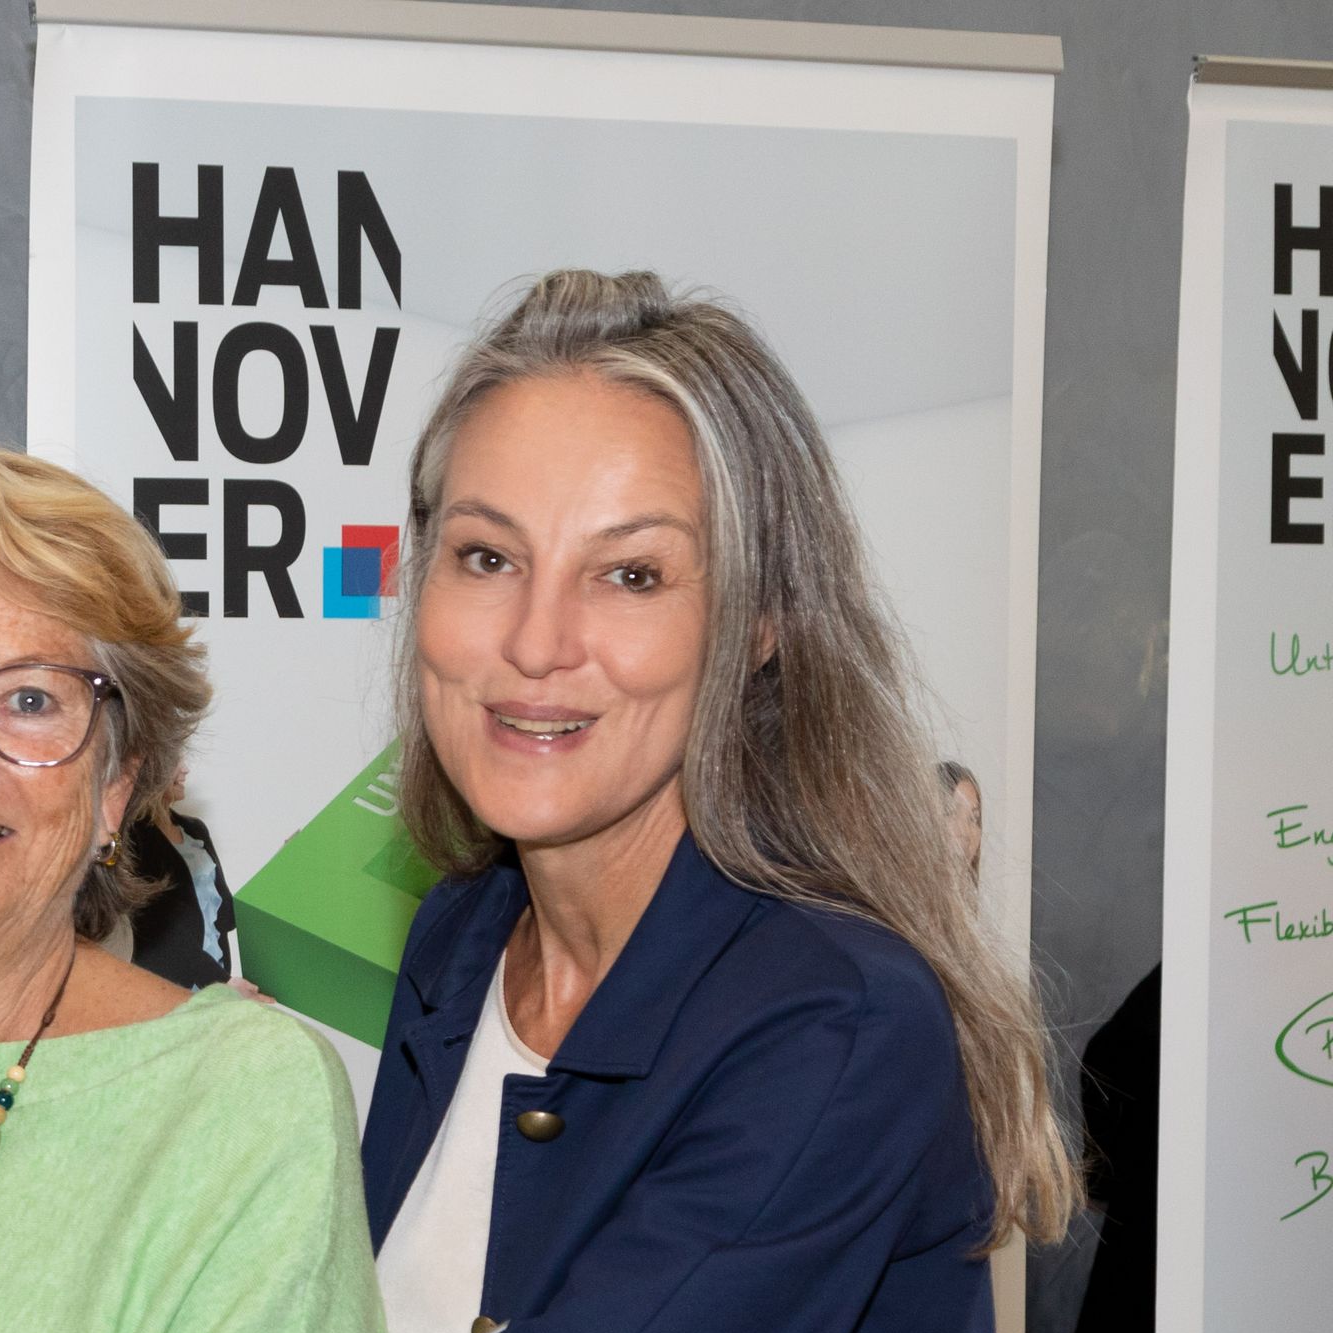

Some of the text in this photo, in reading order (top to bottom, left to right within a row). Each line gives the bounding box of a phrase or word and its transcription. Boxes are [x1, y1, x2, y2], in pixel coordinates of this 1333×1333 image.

[132, 162, 401, 310] HAN
[132, 320, 400, 466] NOV
[1273, 309, 1333, 420] N
[134, 478, 305, 619] ER
